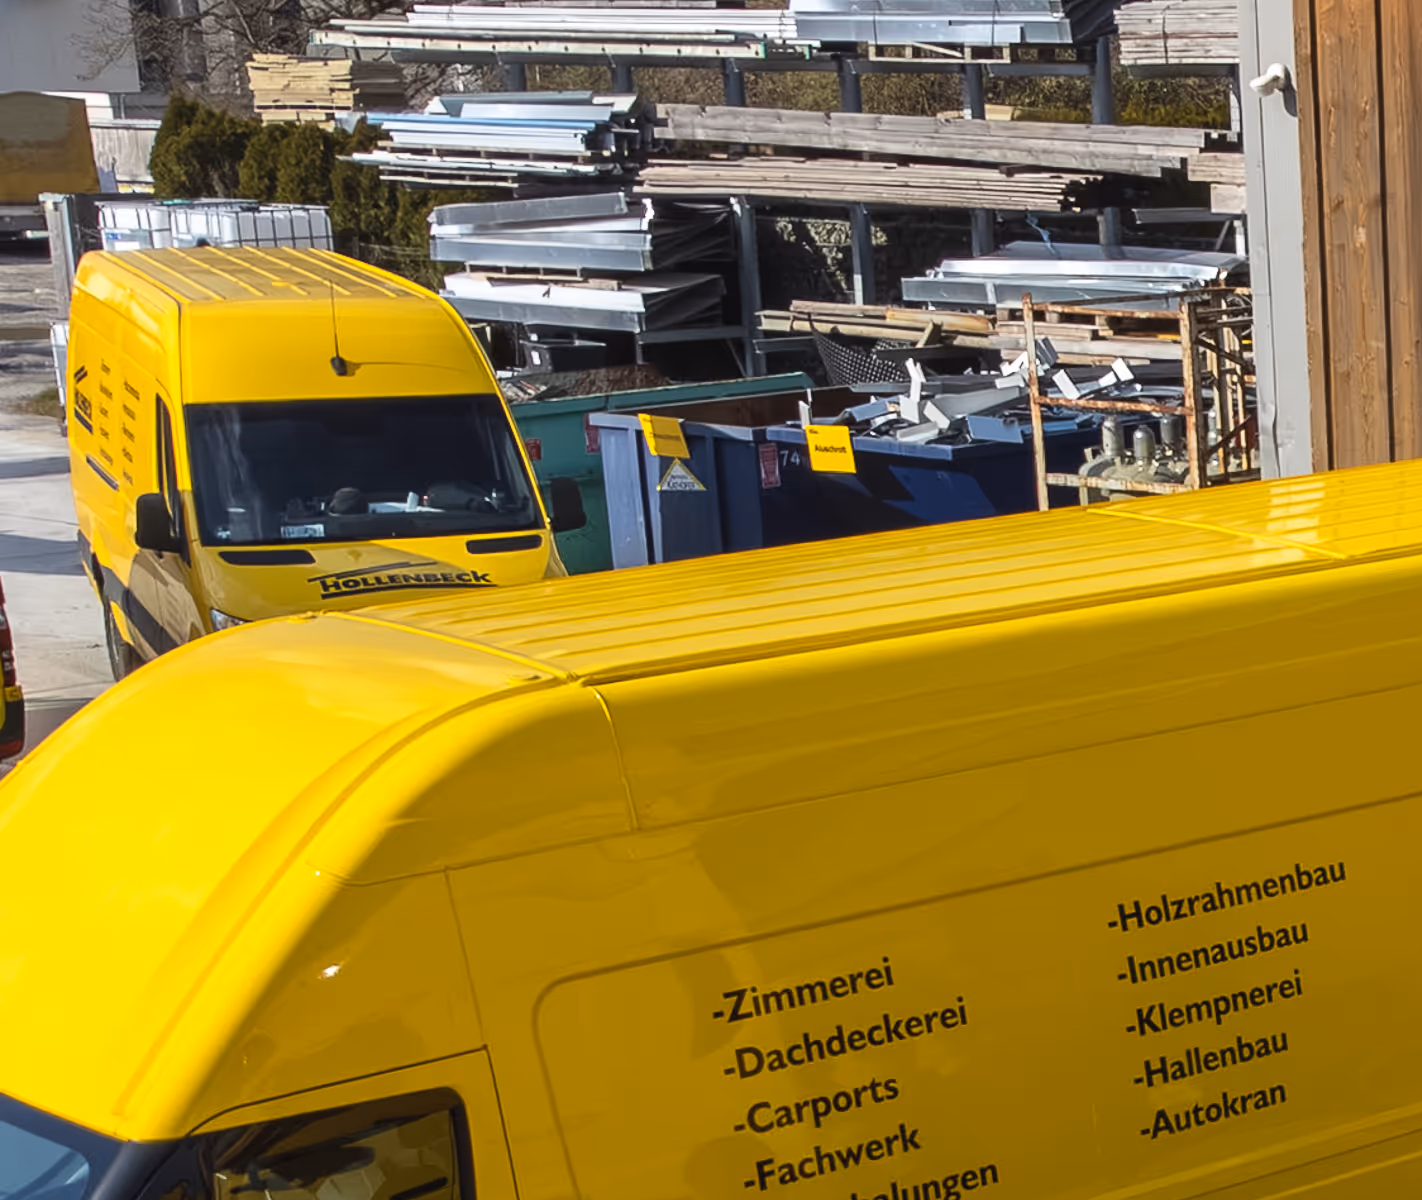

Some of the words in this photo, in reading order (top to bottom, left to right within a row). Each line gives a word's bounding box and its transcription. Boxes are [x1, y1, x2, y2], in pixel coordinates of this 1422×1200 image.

[780, 449, 801, 467] 74
[319, 569, 493, 593] HOLLENBECK
[1107, 861, 1346, 932] -Holzrahmenbau
[1117, 923, 1309, 985] -Innenausbau
[712, 956, 895, 1024] -Zimmerei
[1125, 968, 1303, 1037] -Klempnerei
[723, 995, 968, 1079] -Dachdeckerei
[1133, 1032, 1289, 1088] -Hallenbau
[733, 1077, 900, 1134] -Carports
[1140, 1084, 1287, 1140] -Autokran
[743, 1123, 922, 1192] -Fachwerk
